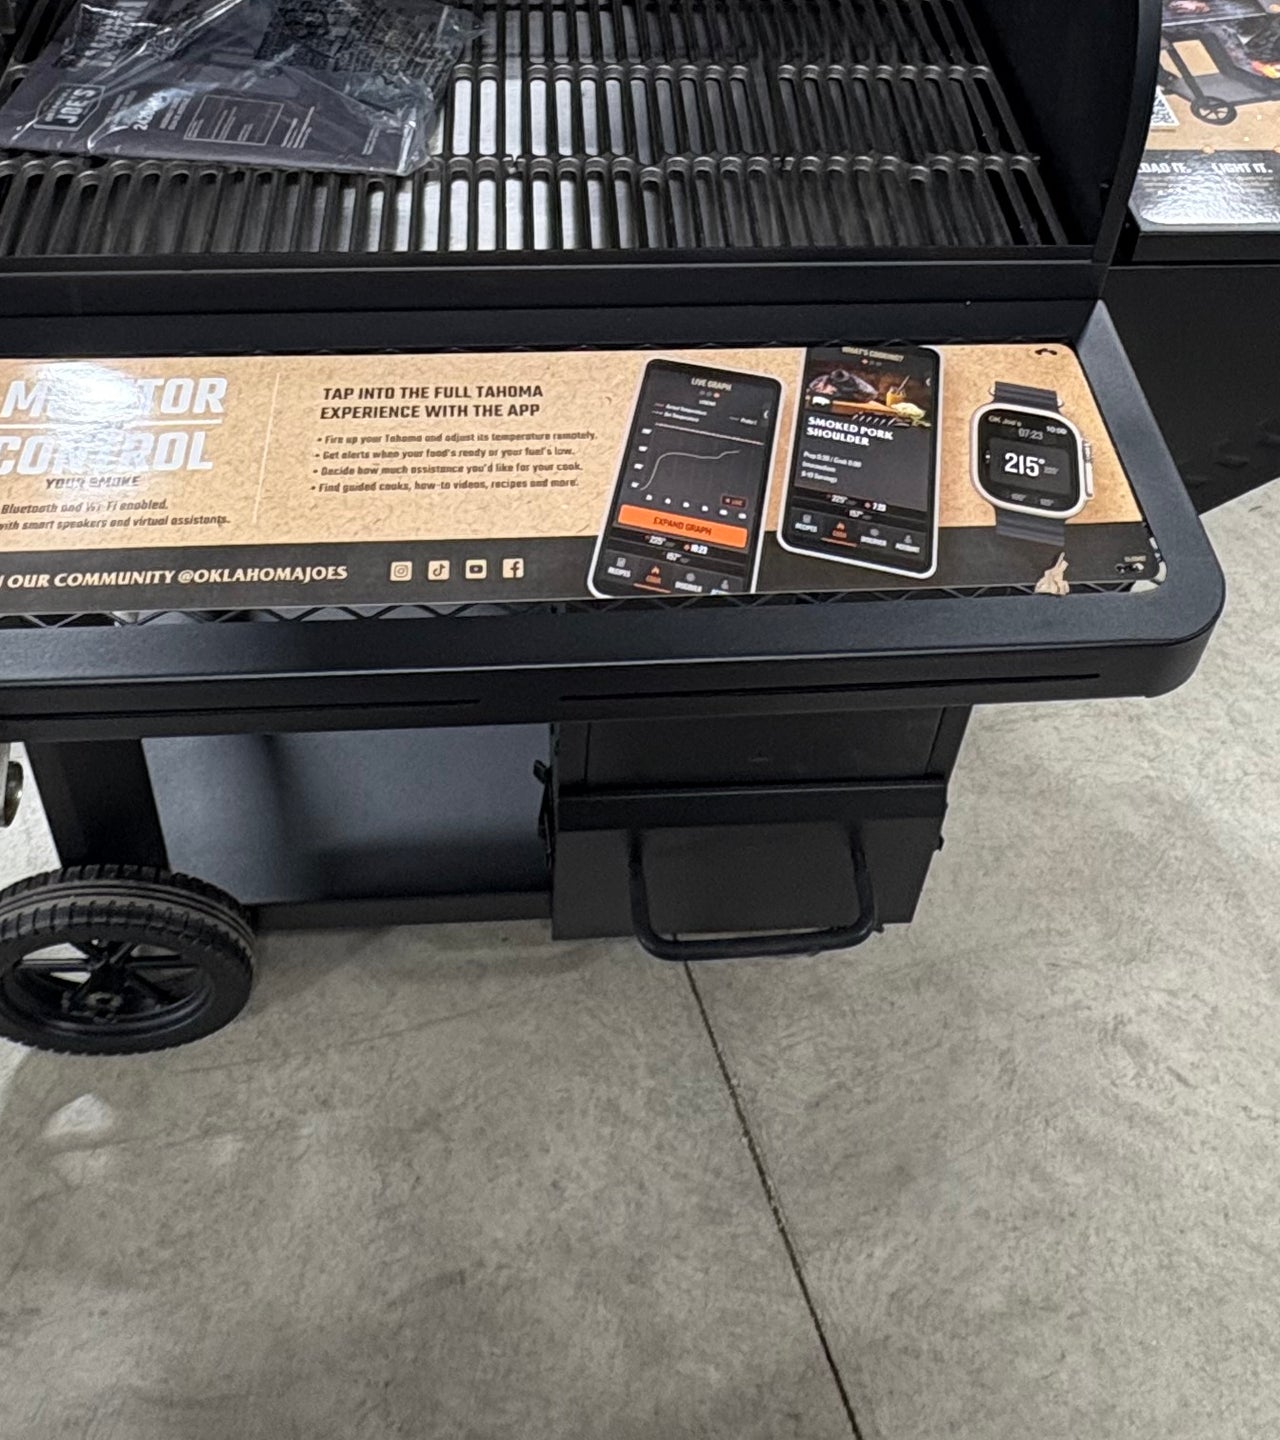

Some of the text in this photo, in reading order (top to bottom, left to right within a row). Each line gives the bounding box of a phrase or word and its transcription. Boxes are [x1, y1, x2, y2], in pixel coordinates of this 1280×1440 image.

[55, 88, 97, 124] JOE'S
[323, 385, 543, 400] TAP INTO THE FULL TAHOMA
[691, 378, 732, 391] LIVE GRAPH
[0, 377, 228, 418] MTOR
[320, 404, 540, 419] EXPERIENCE WITH THE APP
[808, 416, 894, 441] SMOKED PORK
[325, 432, 598, 445] Fire up your Tahoma and adjust its temperature remotely.
[806, 427, 870, 447] SHOULDER
[323, 447, 576, 459] Get alerts when your food's ready or your fuel's low.
[321, 461, 584, 476] Decide how much assistance you'd like for your cook.
[319, 483, 340, 492] Find
[343, 481, 376, 493] guided
[454, 479, 488, 490] videos,
[491, 478, 527, 489] recipes
[530, 478, 548, 488] and
[551, 478, 579, 488] more.
[1, 504, 57, 514] Bluetooth
[61, 502, 84, 513] and
[120, 498, 168, 510] enabled.
[22, 520, 53, 530] smart
[57, 517, 107, 530] speakers
[110, 516, 130, 527] and
[133, 515, 168, 526] virtual
[171, 514, 231, 527] assistants.
[653, 517, 712, 535] EXPAND GRAPH
[7, 572, 51, 588] OUR
[54, 570, 176, 588] COMMUNITY
[177, 566, 348, 584] @OKLAHOMAJOES
